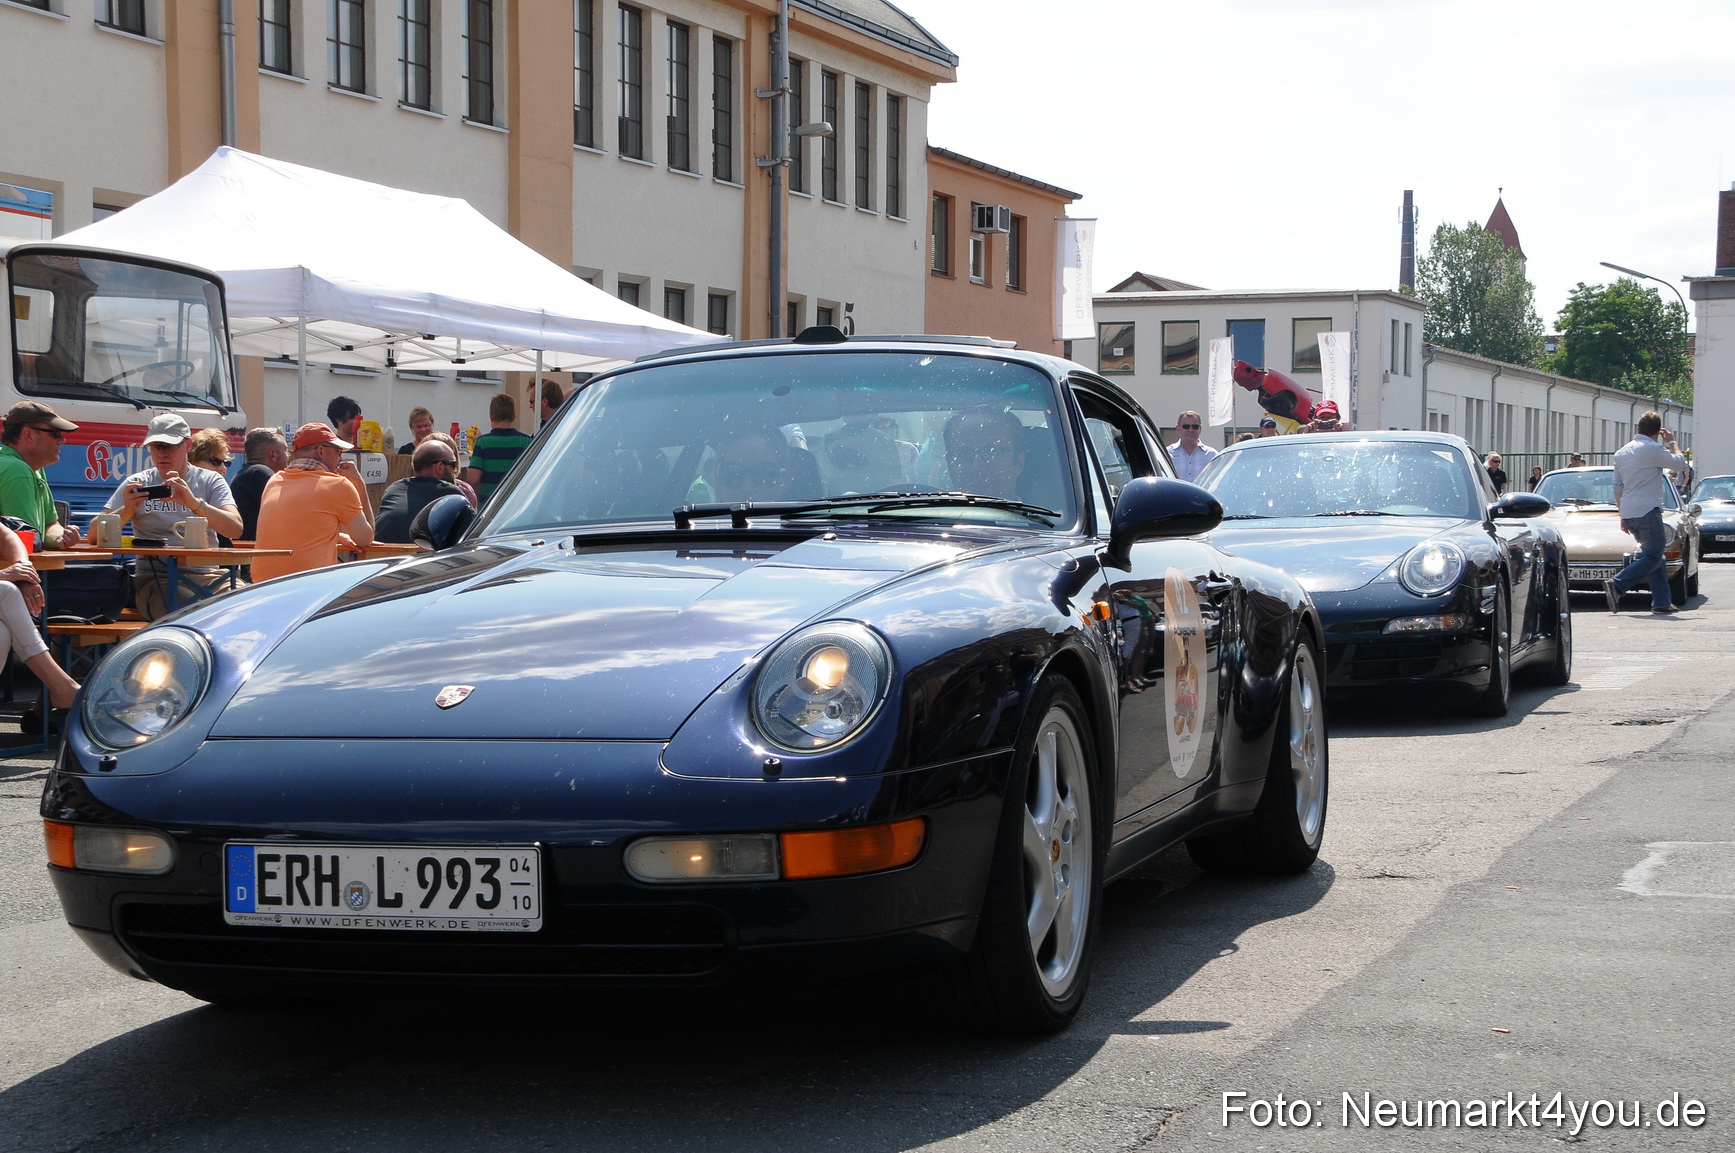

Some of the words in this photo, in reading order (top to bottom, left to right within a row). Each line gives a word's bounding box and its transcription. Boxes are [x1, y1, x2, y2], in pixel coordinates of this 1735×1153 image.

[843, 301, 855, 335] 5
[371, 470, 382, 478] 4,50
[510, 857, 530, 873] 04
[236, 886, 247, 901] D
[257, 854, 340, 907] ERH
[377, 856, 403, 908] L
[417, 857, 502, 910] 993
[512, 895, 531, 910] 10
[291, 917, 470, 929] WWW.OFENWERK.DE
